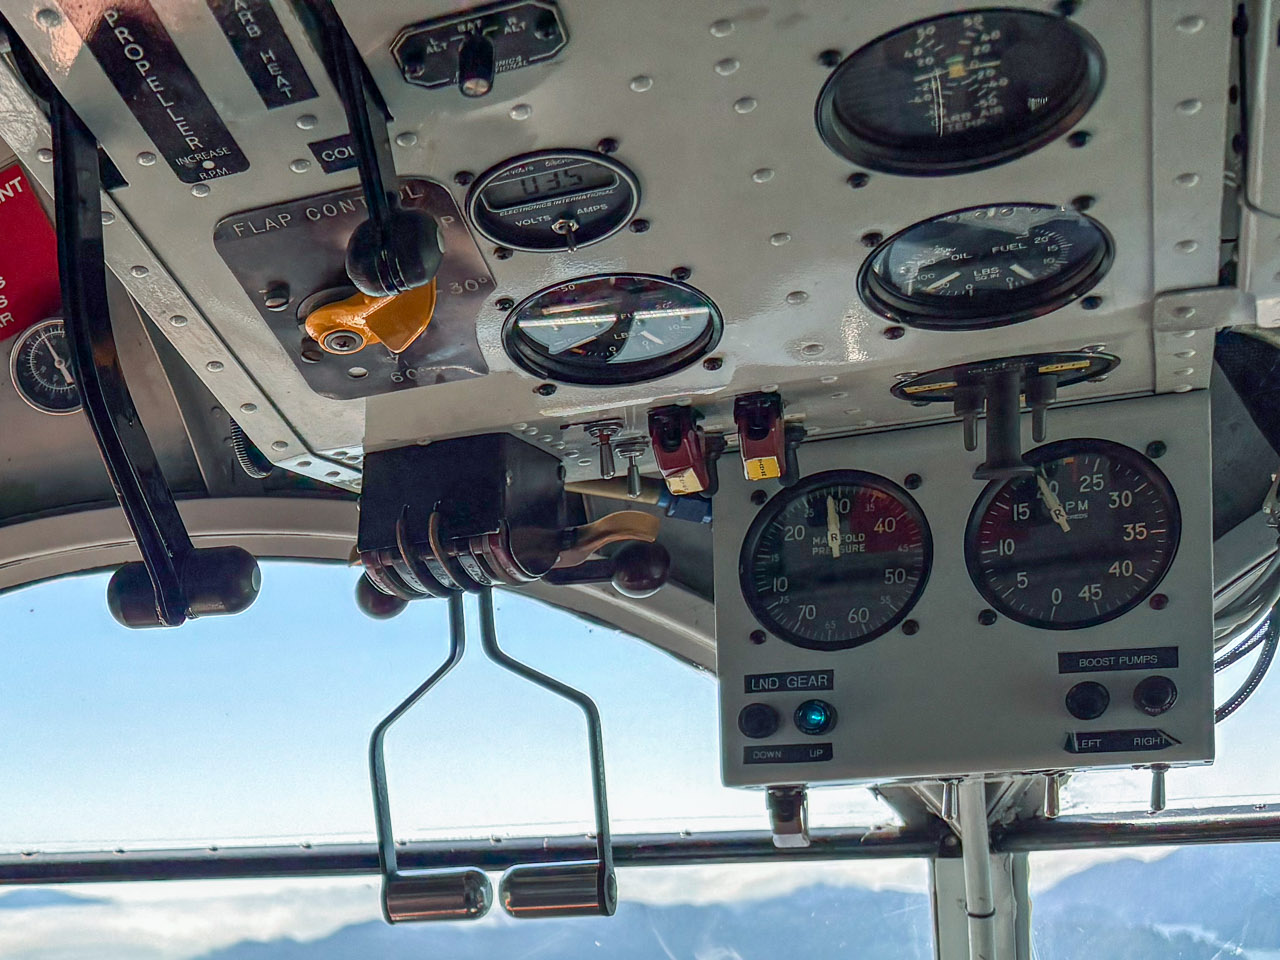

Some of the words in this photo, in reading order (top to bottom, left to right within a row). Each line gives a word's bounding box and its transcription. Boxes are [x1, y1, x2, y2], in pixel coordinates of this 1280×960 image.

[104, 10, 203, 150] PROPELLER
[260, 48, 291, 98] HEAT
[176, 147, 231, 166] INCREASE
[200, 168, 231, 180] R.P.M.
[577, 204, 608, 214] AMPS
[232, 213, 291, 236] FLAP
[515, 215, 551, 226] VOLTS
[992, 243, 1027, 254] FUEL
[951, 253, 972, 261] OIL
[1079, 474, 1104, 492] 25
[1109, 491, 1132, 508] 30
[1014, 503, 1030, 520] 15
[785, 525, 805, 541] 20
[874, 517, 895, 533] 40
[1123, 523, 1147, 541] 35
[1000, 539, 1014, 555] 10
[884, 568, 906, 584] 50
[1108, 560, 1132, 577] 40
[773, 577, 788, 592] 10
[1017, 572, 1028, 588] 5
[1052, 588, 1062, 604] 0
[1078, 584, 1102, 601] 45
[799, 605, 816, 619] 70
[848, 608, 869, 623] 60
[1080, 656, 1115, 667] BOOST
[1120, 655, 1158, 665] PUMPS
[752, 677, 779, 690] LND
[787, 675, 827, 688] GEAR
[753, 751, 782, 759] DOWN
[809, 749, 823, 757] UP
